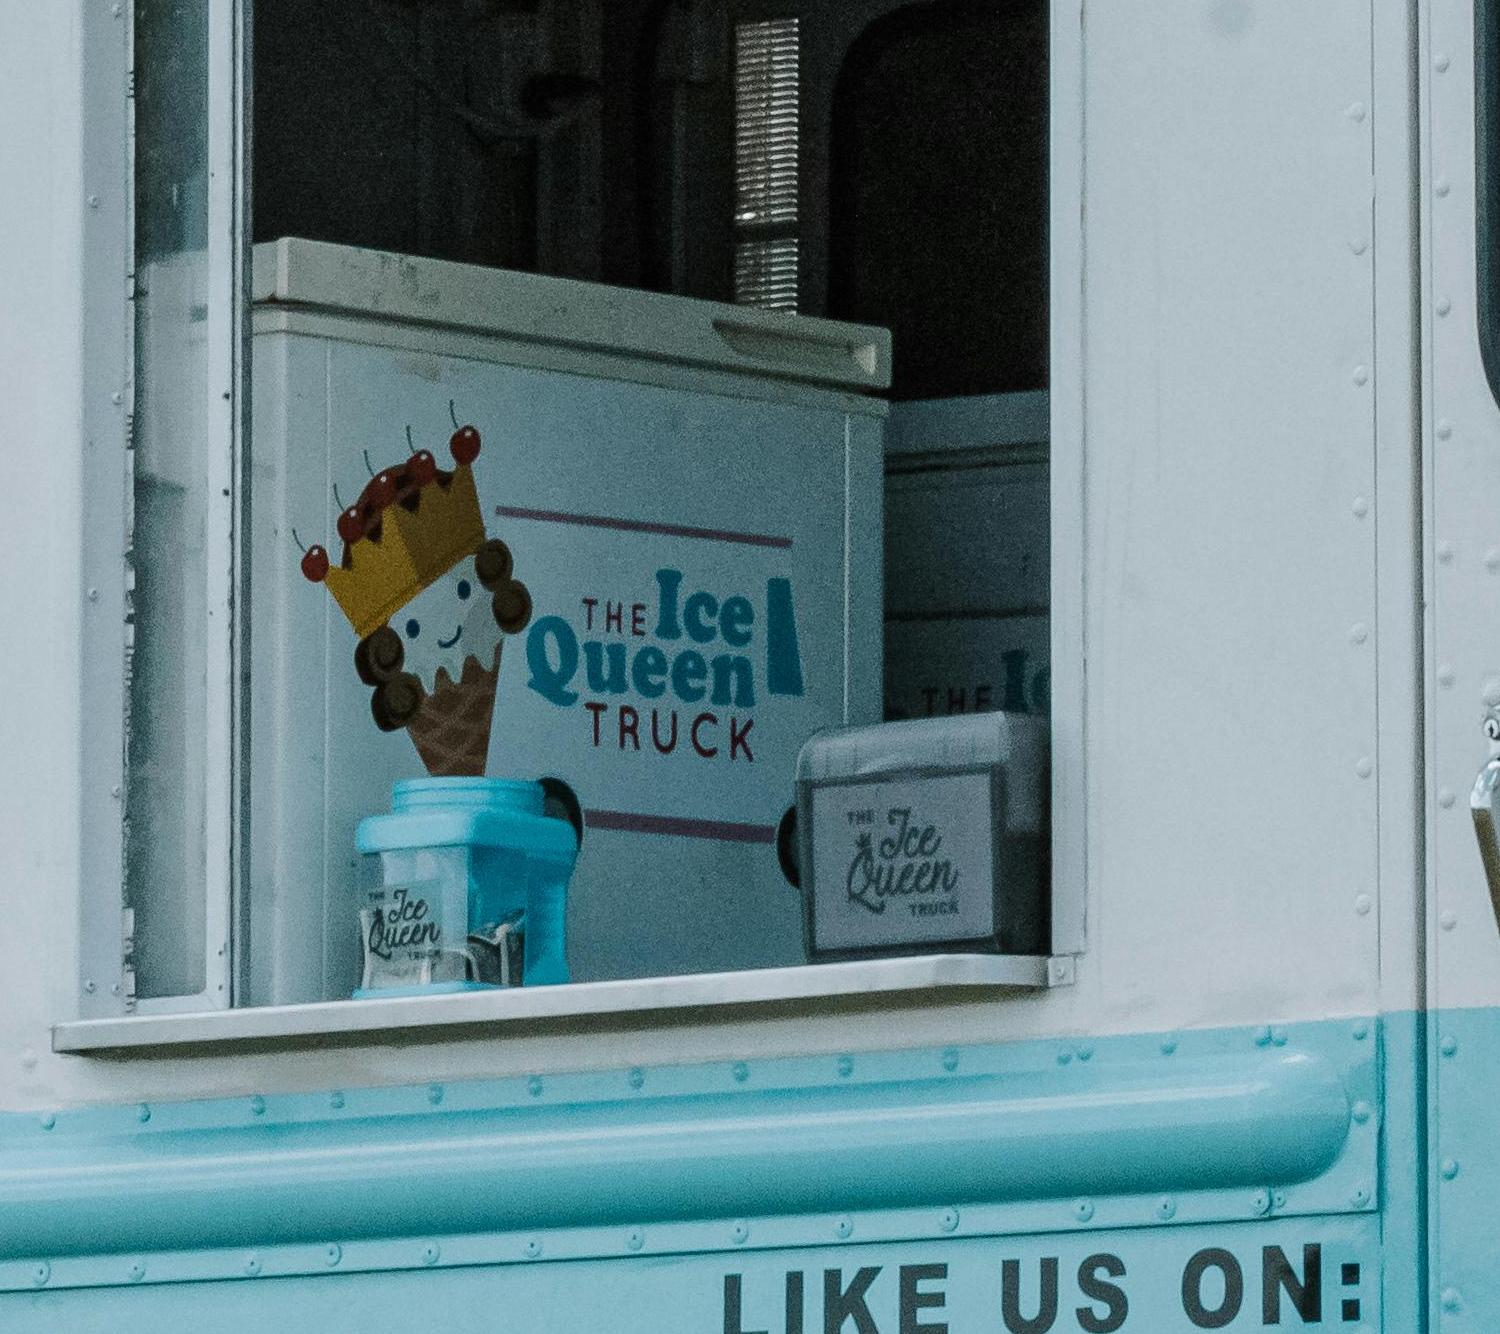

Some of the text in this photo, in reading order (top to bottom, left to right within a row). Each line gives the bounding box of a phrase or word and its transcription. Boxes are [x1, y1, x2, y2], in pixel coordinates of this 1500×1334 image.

[582, 567, 755, 648] THE Ice
[525, 614, 756, 708] Queen
[584, 701, 755, 763] TRUCK
[847, 847, 960, 916] Queen
[1180, 1242, 1362, 1330] ON:
